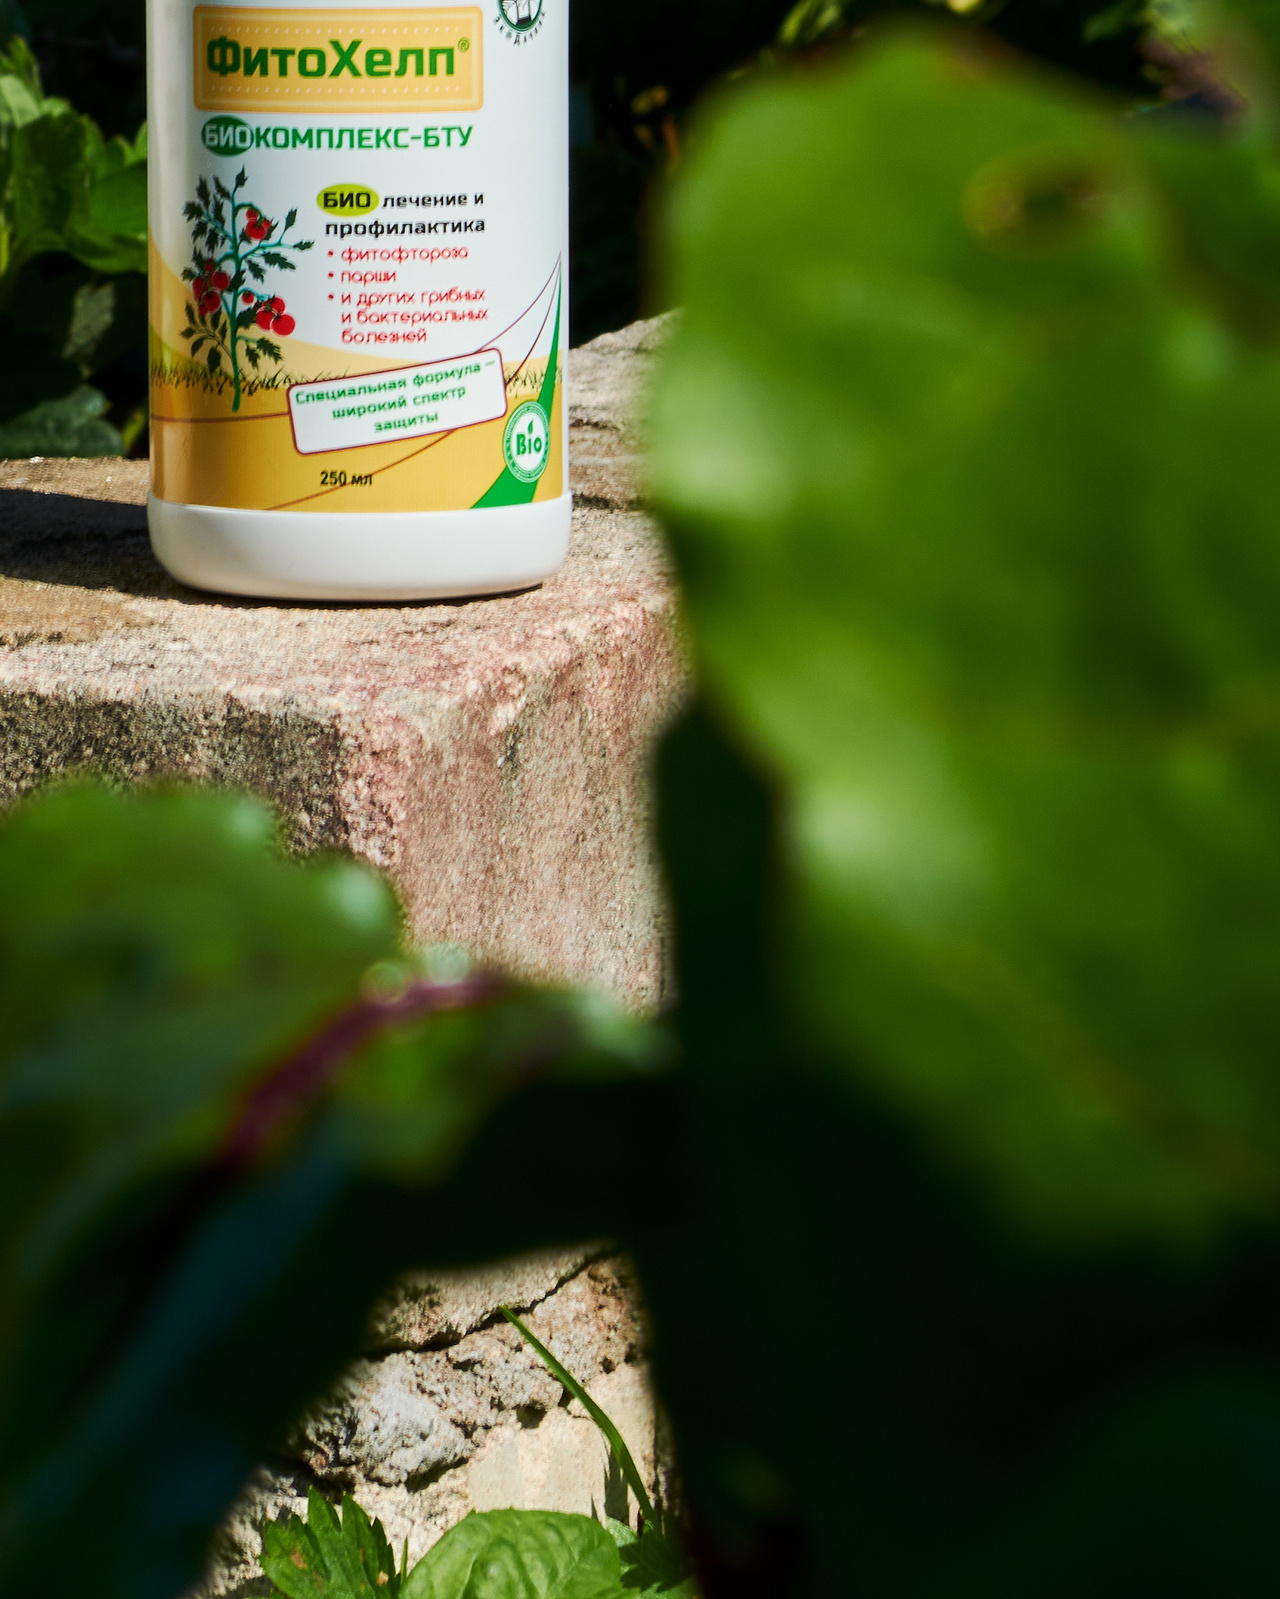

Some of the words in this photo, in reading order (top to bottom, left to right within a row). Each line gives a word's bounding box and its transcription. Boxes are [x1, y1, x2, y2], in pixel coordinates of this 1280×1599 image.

[205, 124, 473, 151] БИОКОМПЛЕКС-БТУ
[322, 192, 372, 210] БИО
[382, 193, 467, 209] лечение
[474, 192, 485, 206] и
[324, 218, 486, 238] профилактика
[340, 245, 469, 263] фитофтороза
[340, 269, 397, 286] парши
[340, 292, 352, 306] и
[356, 291, 414, 310] других
[421, 288, 486, 305] грибных
[340, 309, 352, 323] и
[357, 306, 489, 325] бактериальных
[341, 328, 427, 345] болезней
[295, 377, 408, 405] Специальная
[412, 363, 481, 391] формула
[332, 395, 408, 420] широкий
[412, 383, 467, 408] спектр
[373, 411, 439, 434] защиты
[516, 433, 542, 456] Bio
[319, 471, 348, 487] 250
[351, 474, 374, 487] мл
